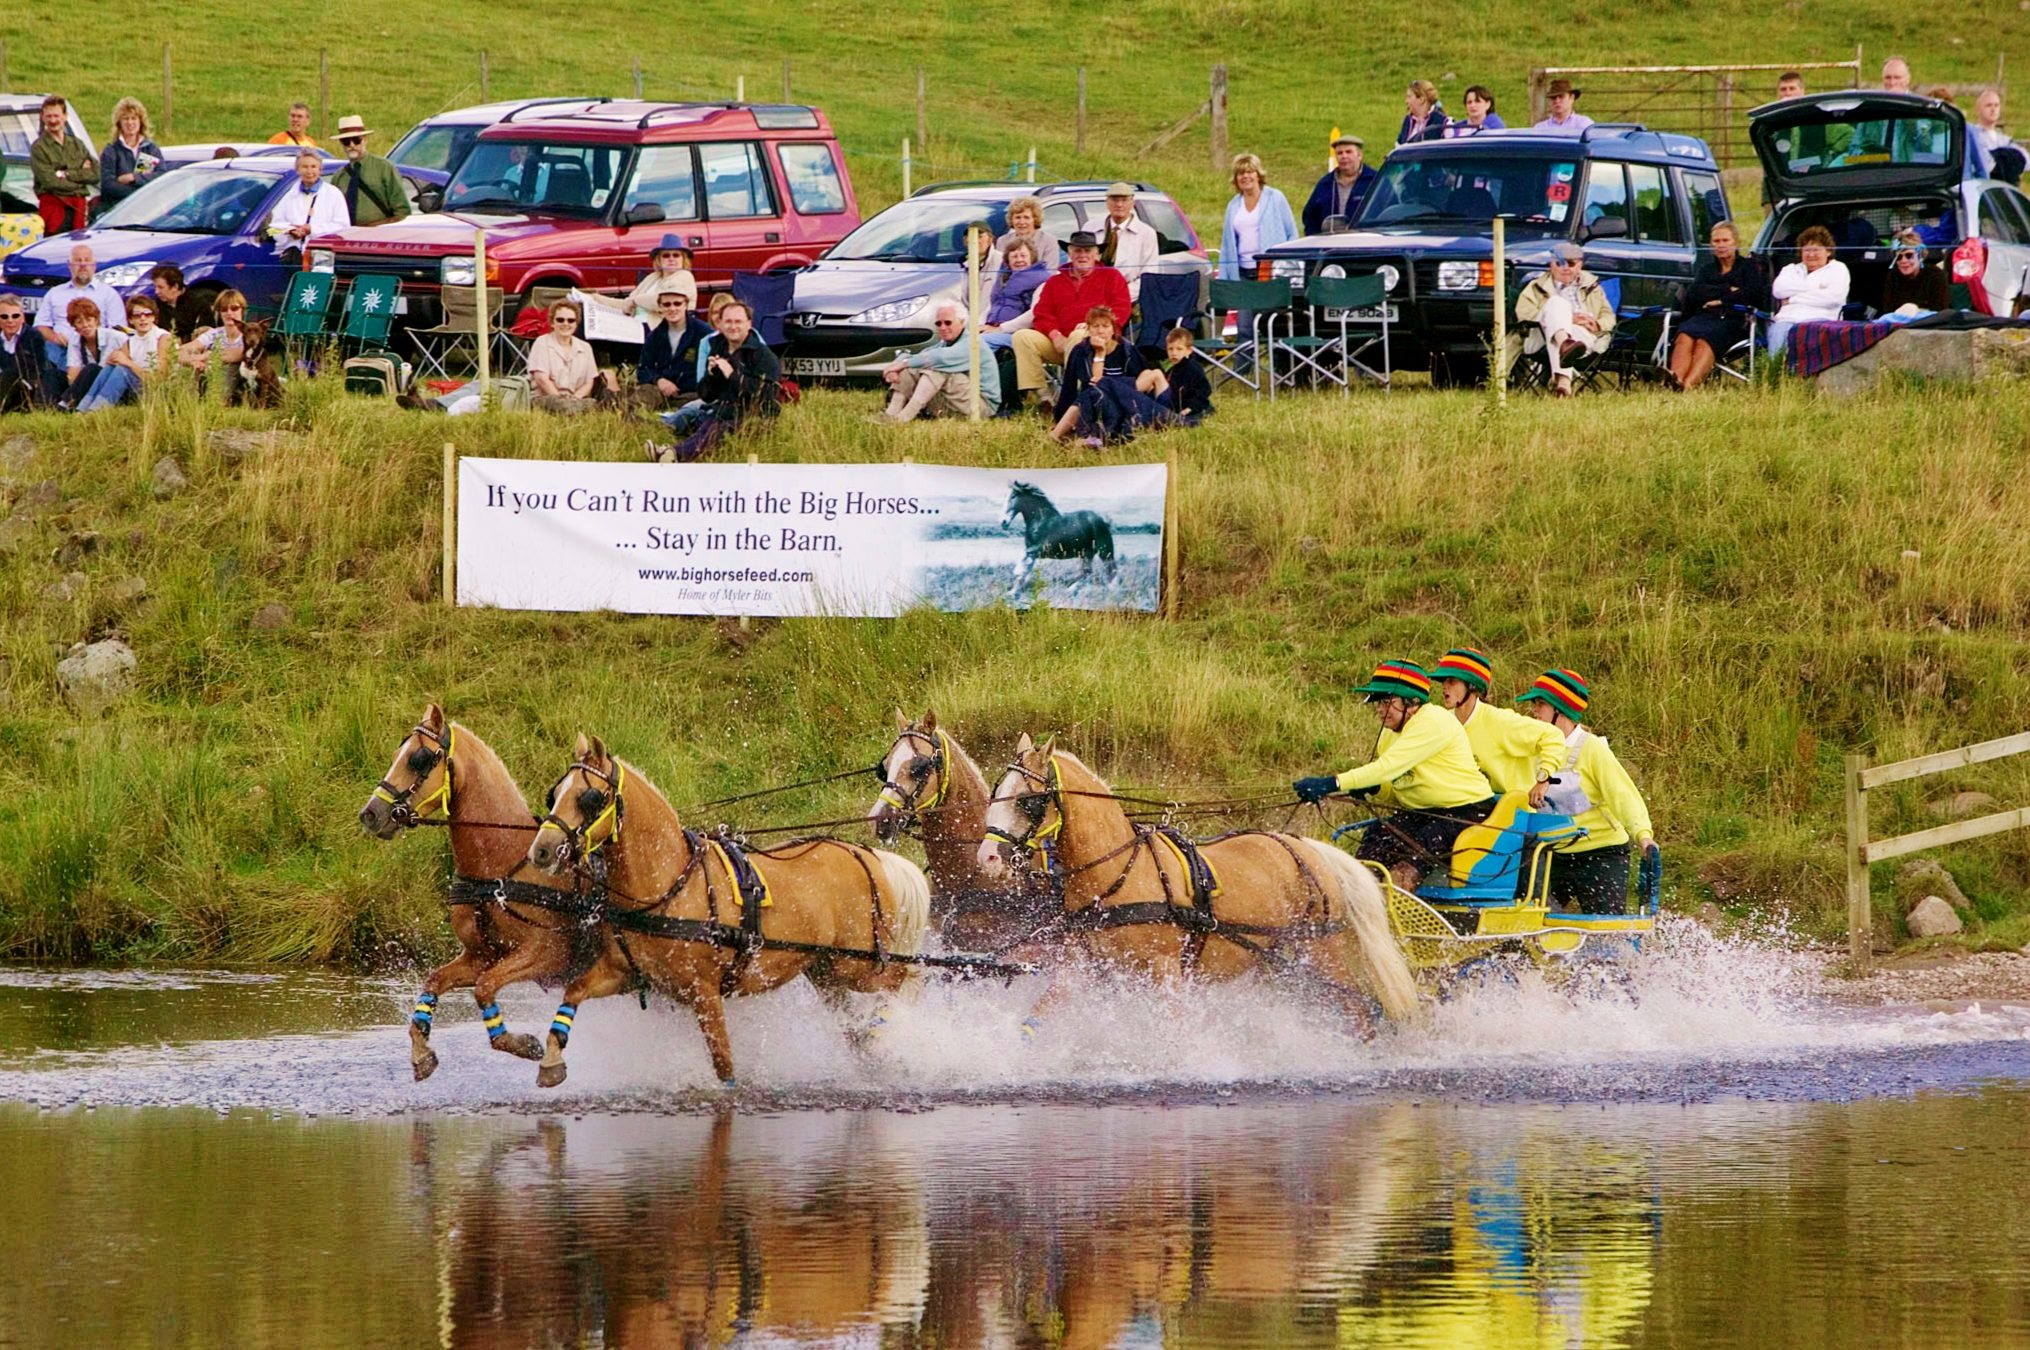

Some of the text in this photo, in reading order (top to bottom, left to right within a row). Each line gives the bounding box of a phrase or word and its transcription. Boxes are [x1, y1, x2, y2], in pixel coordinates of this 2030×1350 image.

[1553, 185, 1567, 197] R
[487, 484, 940, 521] If you Can't Run with the Big Horses...
[647, 526, 699, 556] Stay
[706, 527, 727, 550] in
[735, 527, 771, 551] the
[780, 528, 843, 552] Barn.
[638, 567, 814, 585] www.bighorsefeed.com
[677, 588, 707, 600] Home
[709, 588, 722, 603] of
[753, 588, 773, 601] Bits
